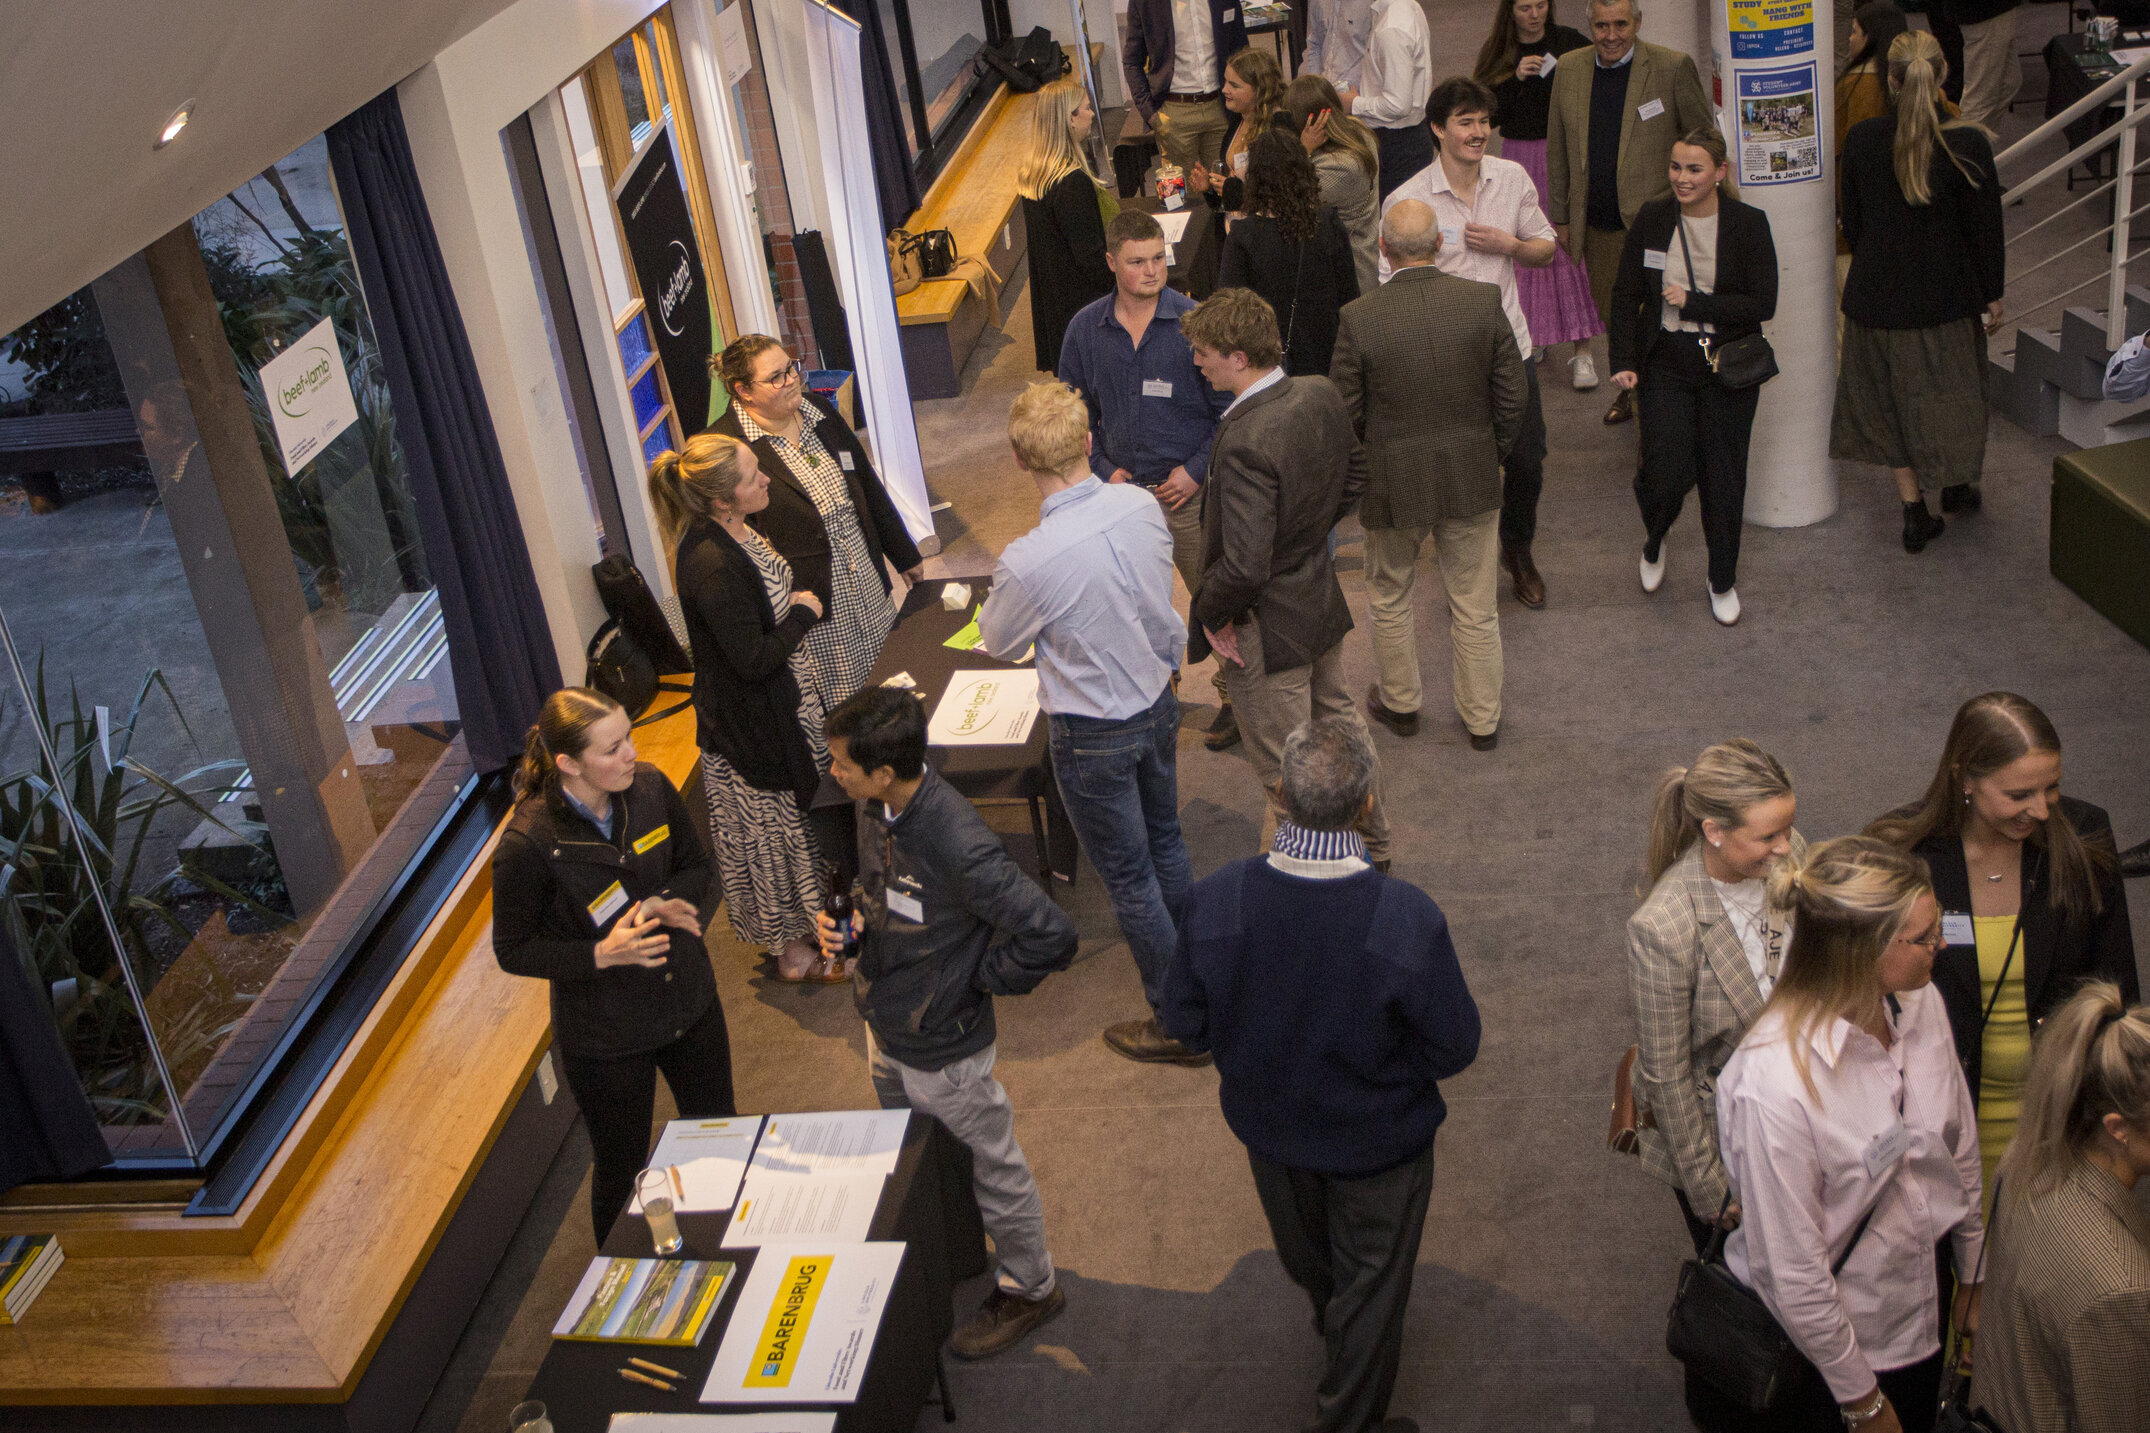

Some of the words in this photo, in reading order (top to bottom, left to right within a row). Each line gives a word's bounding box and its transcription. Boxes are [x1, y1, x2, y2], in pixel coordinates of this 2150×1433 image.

[1763, 6, 1788, 15] HANG
[1789, 2, 1812, 11] WITH
[1769, 10, 1805, 21] FRIENDS
[1783, 27, 1803, 36] CONTACT
[1784, 171, 1800, 179] Join
[1802, 168, 1814, 176] us!
[283, 358, 330, 405] beef+lamb
[956, 682, 992, 730] beef+lamb
[1769, 929, 1782, 961] AJE
[767, 1263, 817, 1362] BARENBRUG
